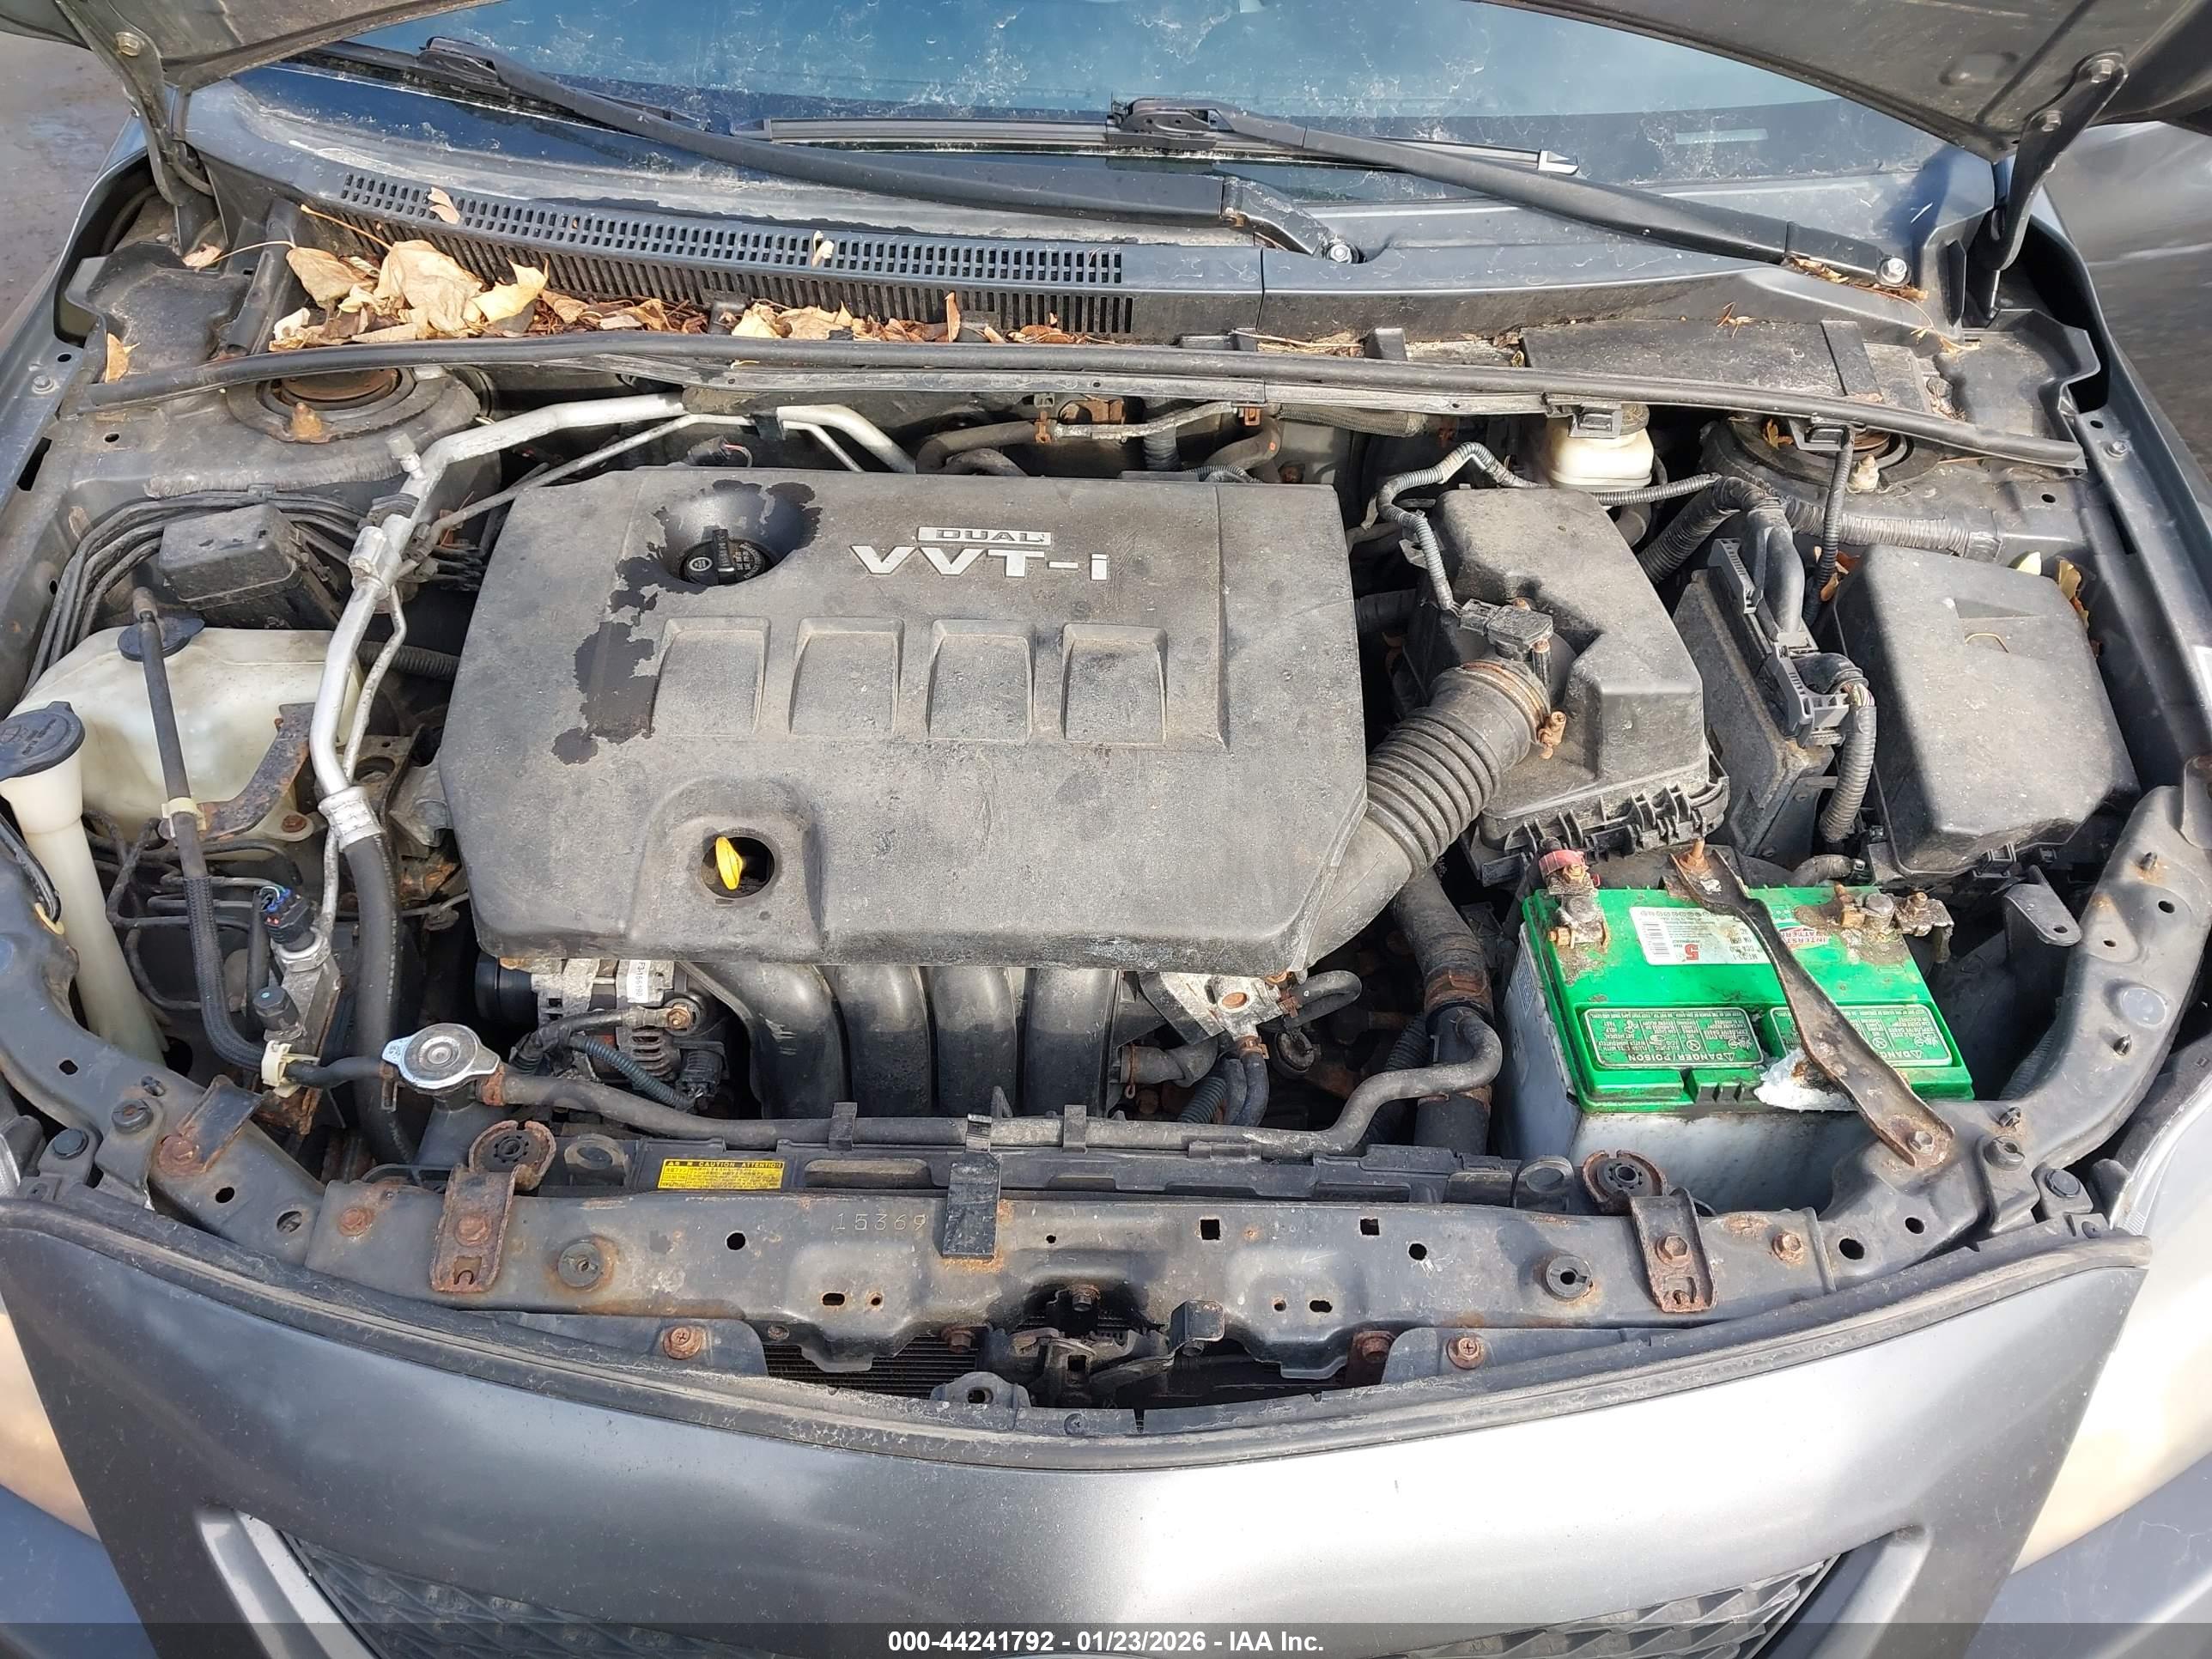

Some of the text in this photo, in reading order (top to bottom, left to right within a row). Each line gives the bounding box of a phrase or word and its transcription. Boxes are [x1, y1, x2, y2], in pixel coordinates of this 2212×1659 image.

[935, 529, 1045, 543] DUAL
[850, 544, 1109, 581] VVT-i
[1685, 944, 1699, 961] 5
